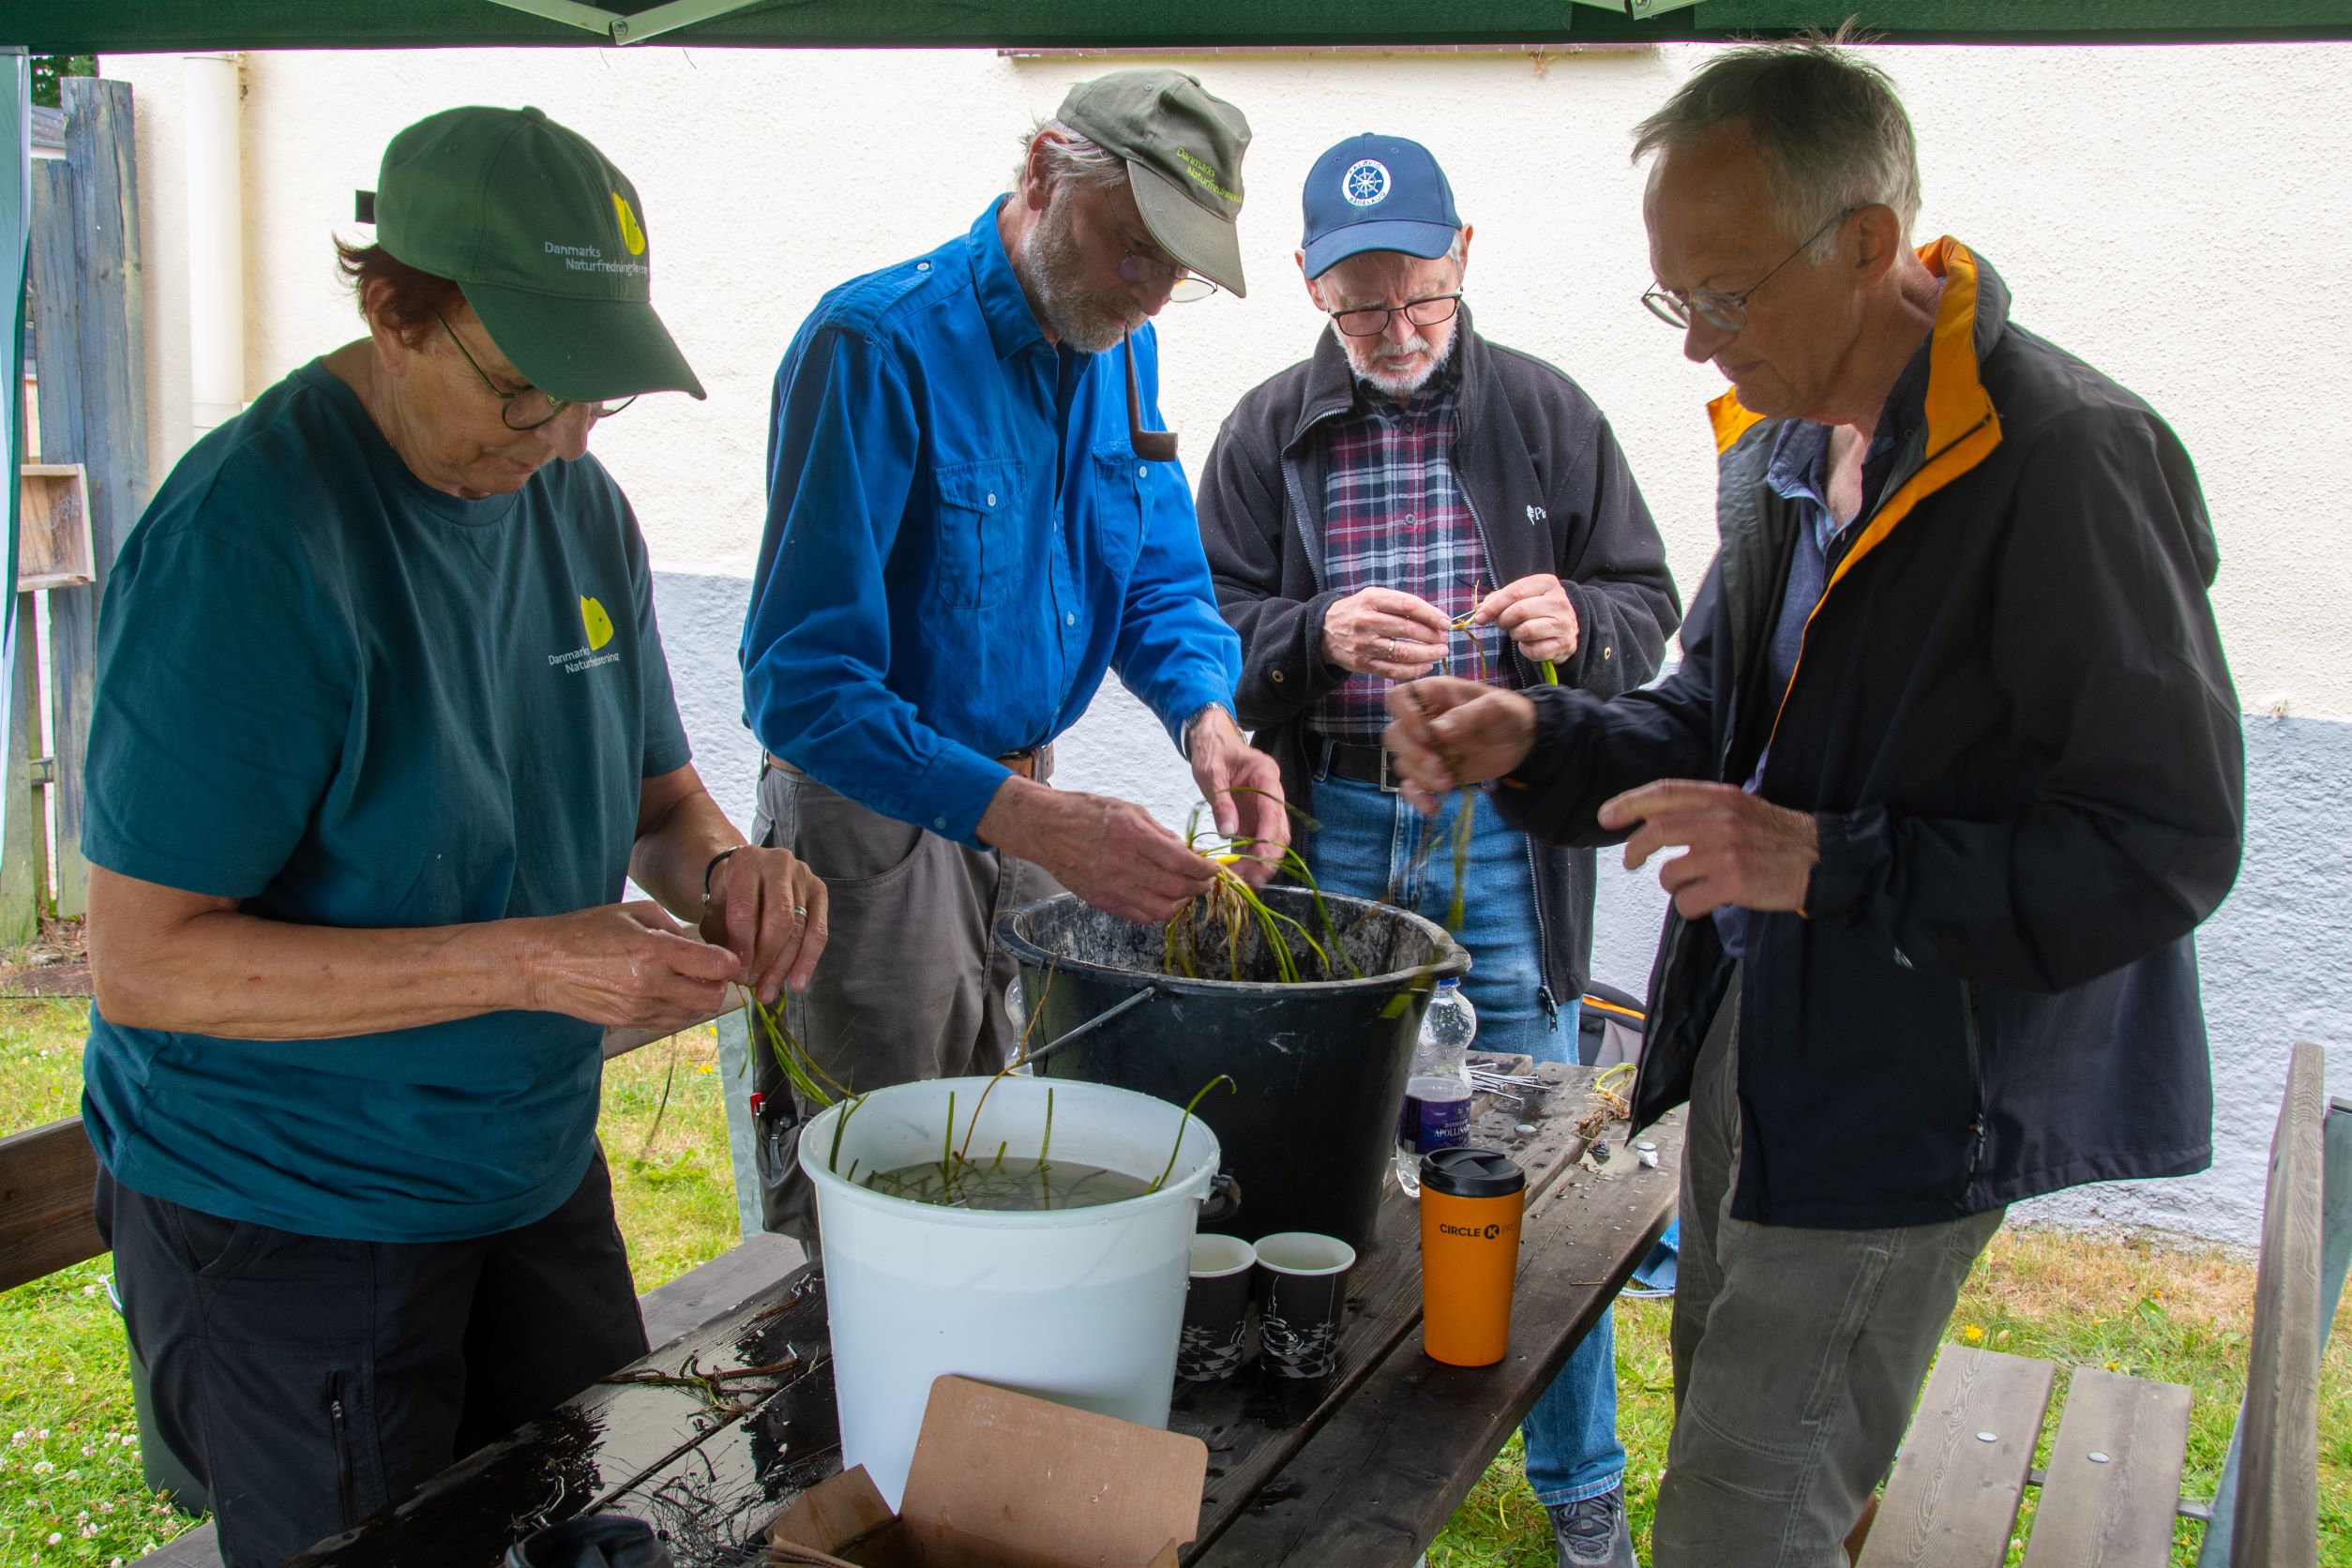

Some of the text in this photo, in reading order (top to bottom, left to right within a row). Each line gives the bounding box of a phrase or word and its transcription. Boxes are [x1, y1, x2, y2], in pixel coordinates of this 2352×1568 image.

[1176, 146, 1215, 178] Danmarks
[544, 241, 601, 258] Danmarks
[548, 645, 590, 666] Danmarks
[1440, 1224, 1481, 1237] CIRCLE
